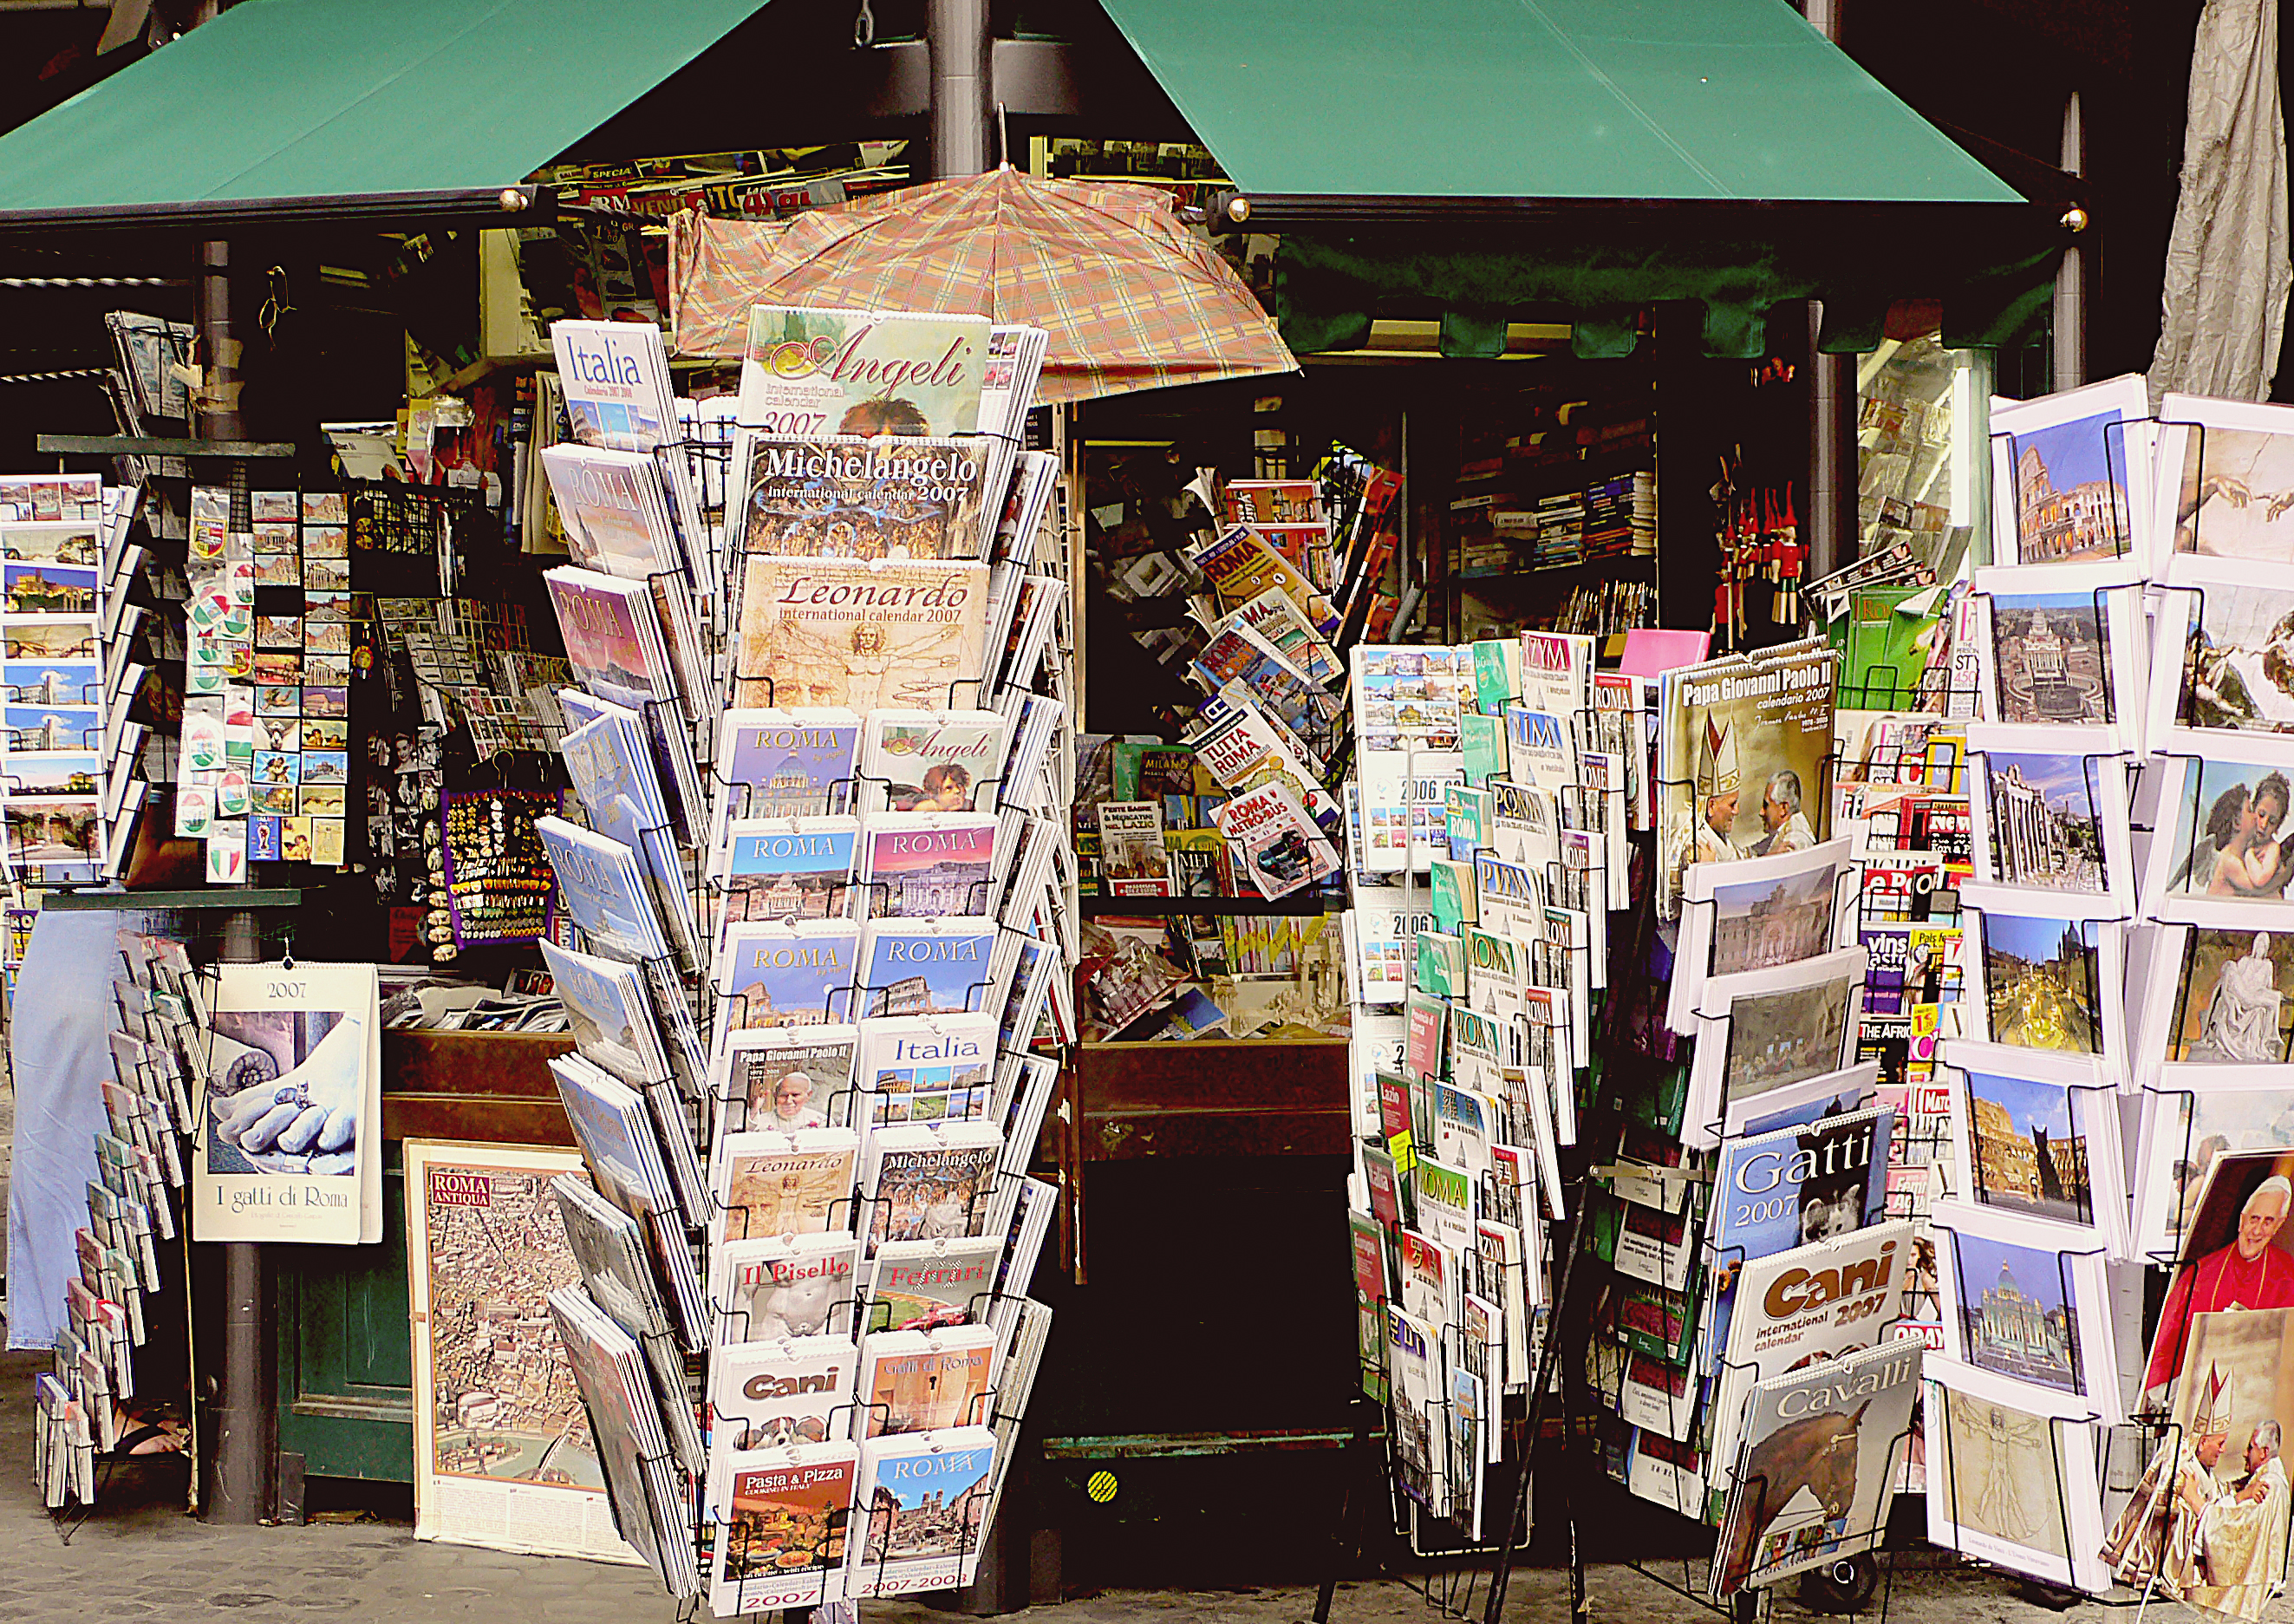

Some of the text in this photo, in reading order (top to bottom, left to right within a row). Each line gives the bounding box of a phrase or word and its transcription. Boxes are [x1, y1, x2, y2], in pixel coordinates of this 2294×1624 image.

[565, 336, 642, 385] Italia
[770, 324, 972, 399] Angeli
[765, 396, 821, 408] calendar
[765, 411, 827, 434] 2007
[766, 447, 977, 487] Michelangelo
[917, 486, 969, 502] 2007
[1204, 541, 1262, 583] ROMA
[775, 577, 969, 610] Leonardo
[869, 609, 924, 623] calendar
[927, 609, 961, 623] 2007
[1683, 661, 1832, 708] Papa Giovanni Paolo II
[1596, 686, 1630, 709] ROMA
[1756, 687, 1830, 710] calendario 2007
[753, 729, 838, 749] ROMA
[891, 729, 993, 766] Angeli
[1203, 727, 1251, 761] TUTTA
[1145, 758, 1189, 770] MILANO
[1214, 740, 1261, 774] ROMA
[1400, 779, 1437, 801] 2006
[1228, 795, 1272, 822] ROMA
[1450, 816, 1477, 840] ROMA
[753, 838, 835, 859] ROMA
[892, 832, 977, 855] ROMA
[887, 940, 980, 962] ROMA
[1867, 933, 1907, 954] vins
[753, 948, 838, 969] ROMA
[267, 982, 307, 999] 2007
[1861, 1024, 1881, 1039] THE
[740, 1051, 765, 1063] Papa
[766, 1048, 810, 1061] Giovanni
[811, 1047, 838, 1059] Paolo
[895, 1035, 981, 1061] Italia
[745, 1157, 843, 1174] Leonardo
[888, 1151, 993, 1170] Michelangelo
[1735, 1125, 1873, 1194] Gatti
[434, 1176, 486, 1193] ROMA
[217, 1184, 348, 1213] I gatti di Roma
[434, 1191, 489, 1206] ANTIQUA
[1735, 1193, 1799, 1227] 2007
[743, 1256, 850, 1285] Il Pisello
[890, 1260, 986, 1287] Ferrari
[1763, 1240, 1897, 1321] Cani
[1835, 1292, 1888, 1327] 2007
[1756, 1311, 1829, 1339] international
[1754, 1331, 1804, 1353] calendar
[942, 1355, 984, 1372] Roma
[743, 1367, 839, 1400] Cani
[1777, 1357, 1911, 1418] Cavalli
[894, 1453, 974, 1479] ROMA
[746, 1468, 844, 1490] Pasta & Pizza
[746, 1590, 818, 1610] 2007
